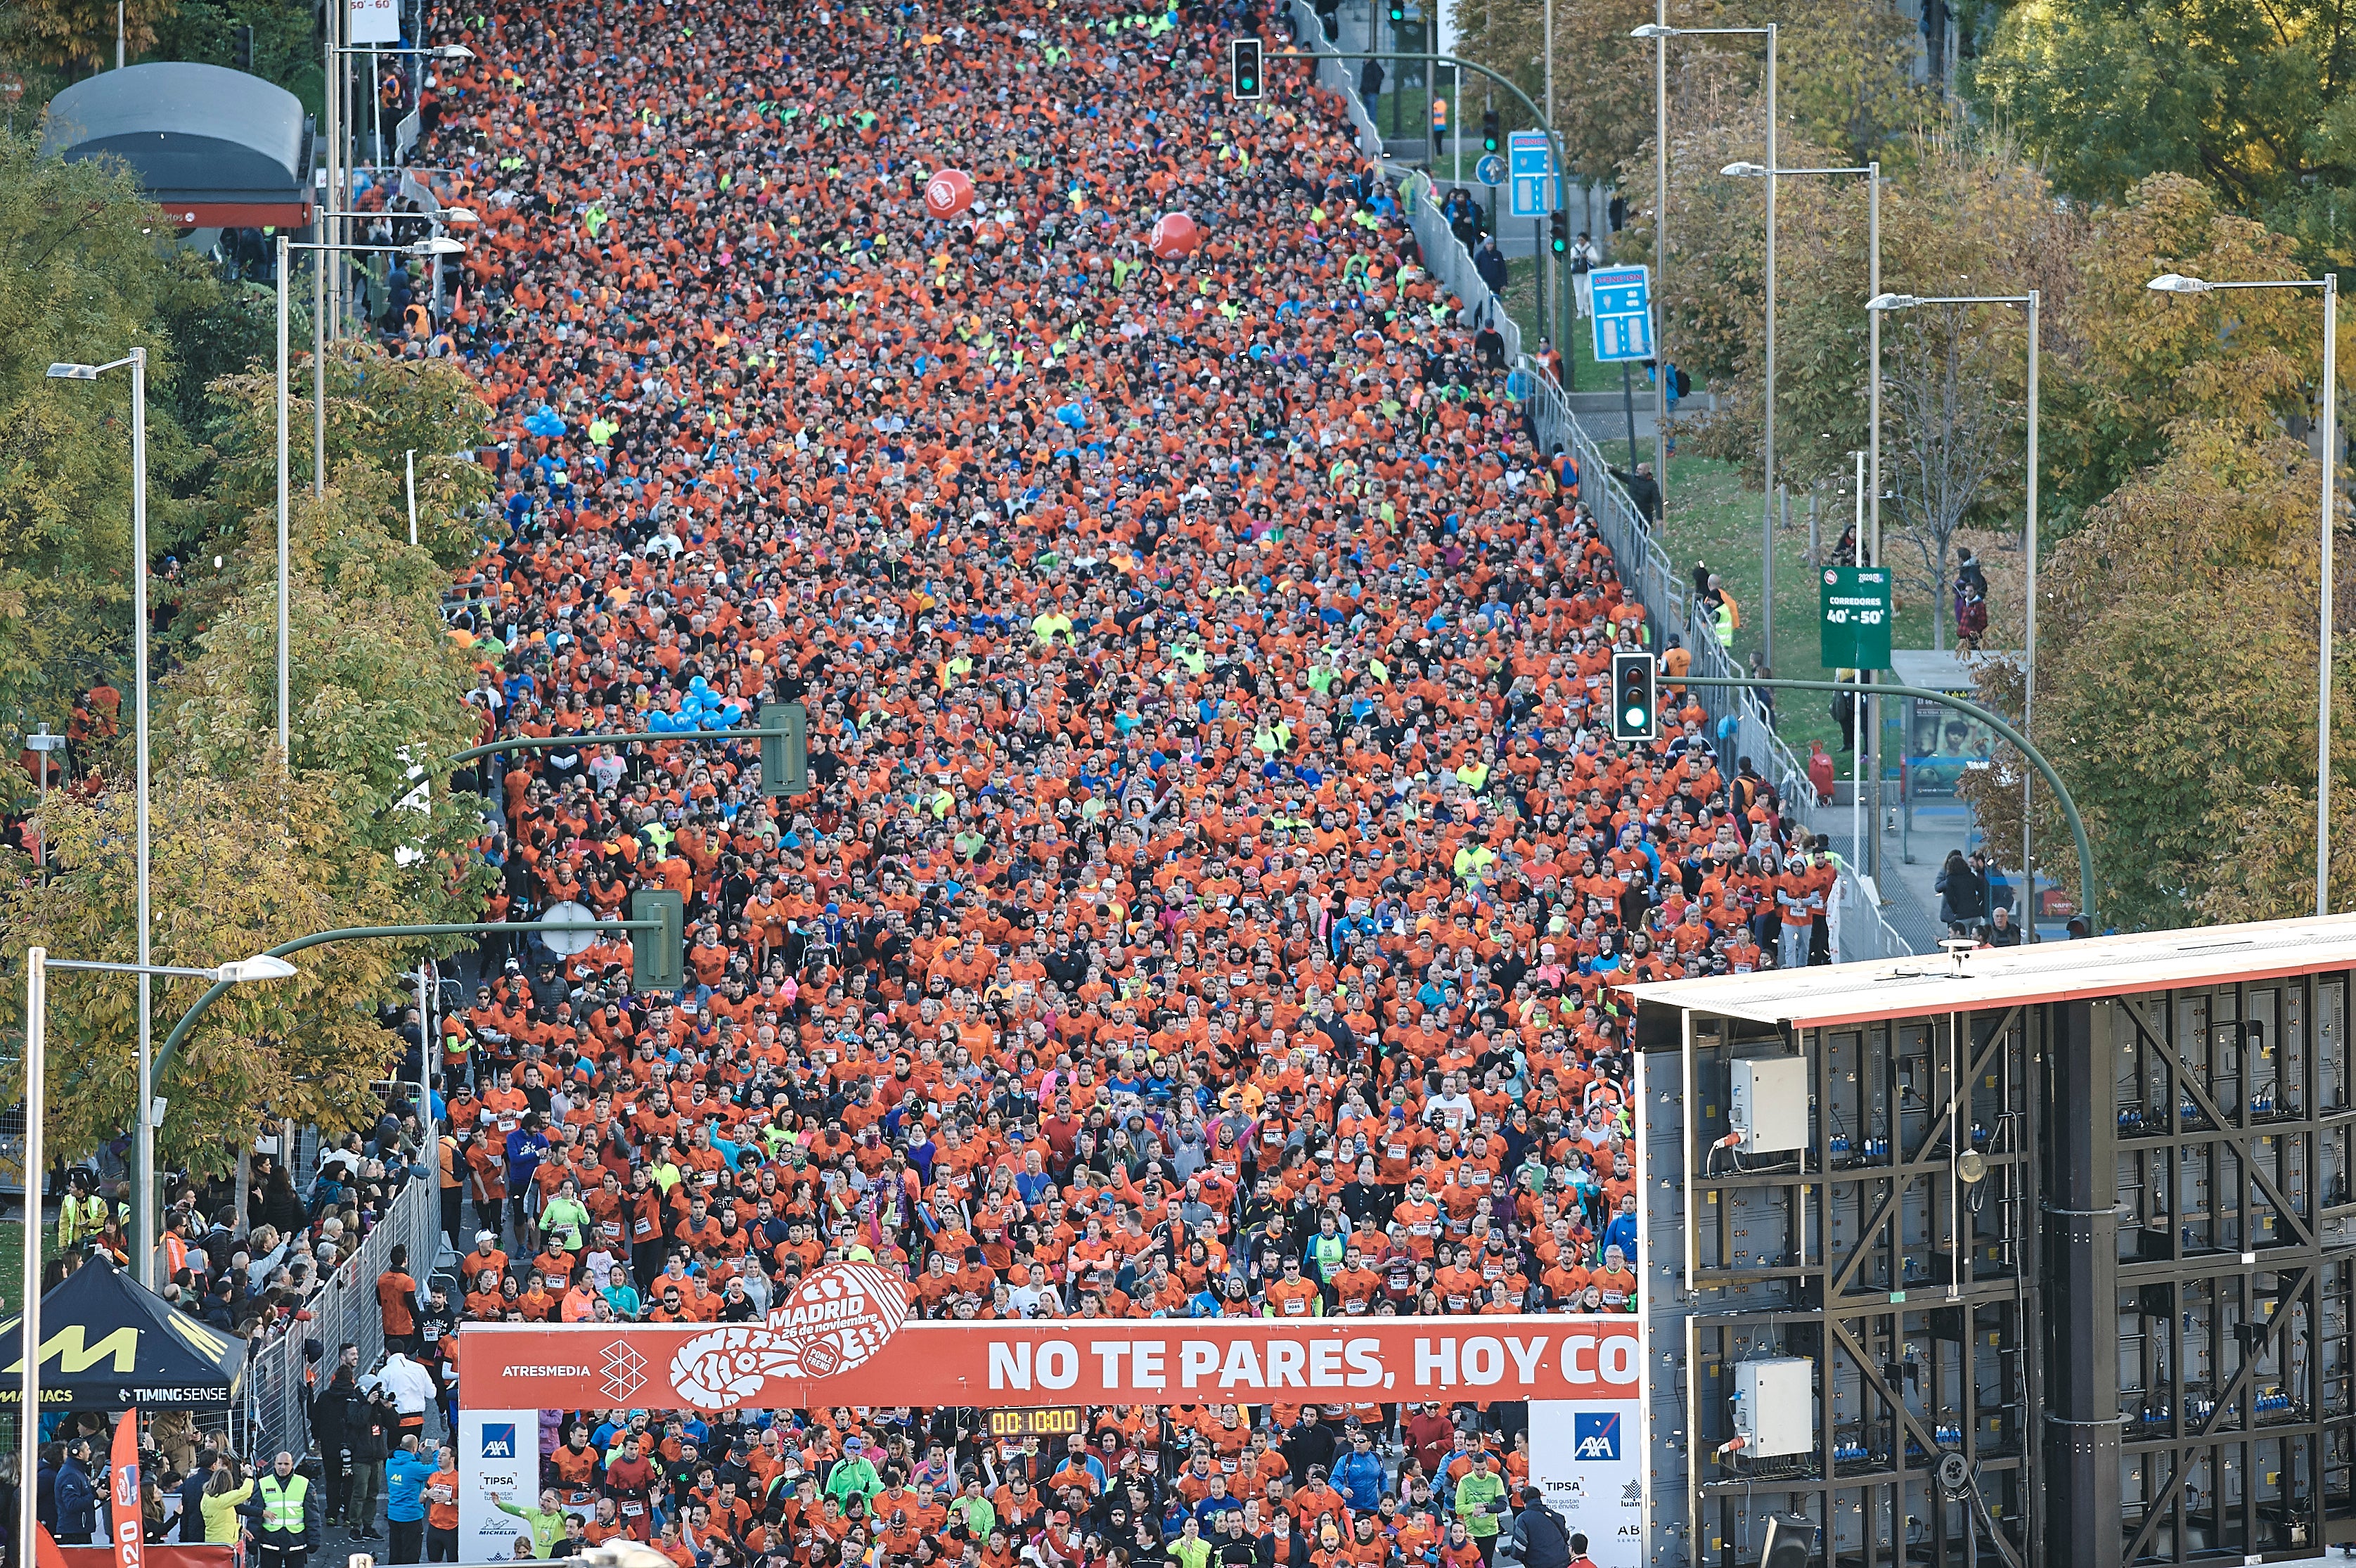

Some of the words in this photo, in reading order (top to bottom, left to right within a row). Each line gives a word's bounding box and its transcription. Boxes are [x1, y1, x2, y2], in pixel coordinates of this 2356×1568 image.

[1595, 274, 1642, 284] ATENCIÓN
[1829, 597, 1881, 606] CORREDORES
[1827, 608, 1850, 623] 40'
[1860, 609, 1884, 624] 50'
[768, 1296, 864, 1330] MADRID
[782, 1328, 798, 1339] 26
[799, 1324, 814, 1336] de
[815, 1313, 877, 1332] noviembre
[806, 1356, 830, 1371] FRENO
[810, 1348, 834, 1364] PONLE
[989, 1340, 1079, 1389] NO
[1091, 1341, 1166, 1388] TE
[1182, 1337, 1395, 1389] PARES,
[1415, 1336, 1549, 1385] HOY
[1560, 1335, 1640, 1384] CO
[502, 1365, 591, 1377] ATRESMEDIA
[0, 1389, 73, 1402] MAIACS
[992, 1410, 1076, 1434] 00:10:00
[482, 1441, 510, 1455] AXA
[1575, 1437, 1613, 1456] AXA
[1545, 1482, 1580, 1491] TIPSA
